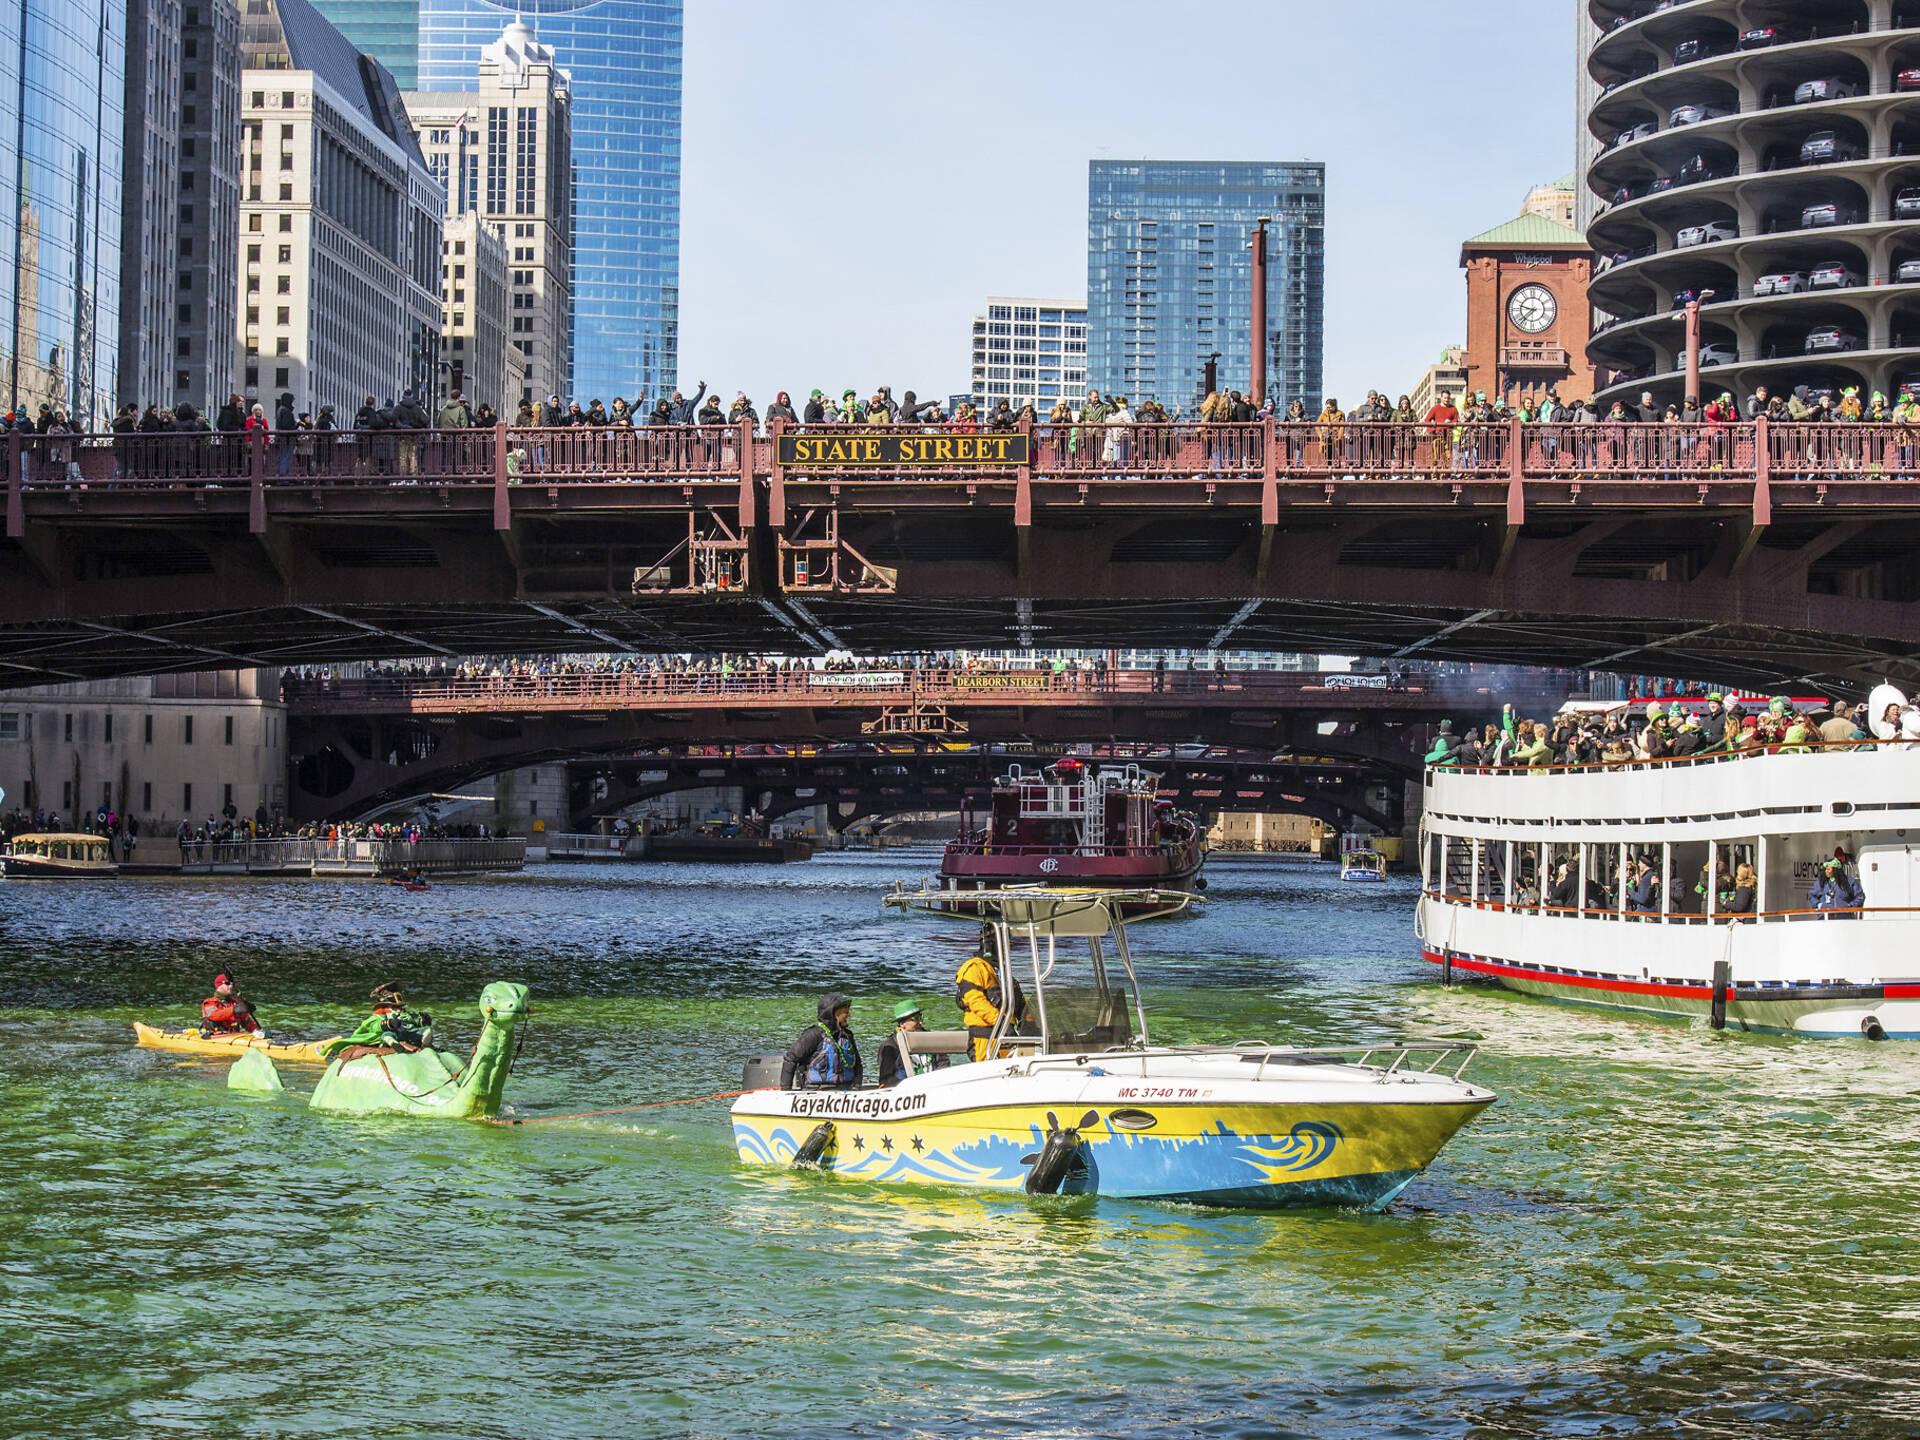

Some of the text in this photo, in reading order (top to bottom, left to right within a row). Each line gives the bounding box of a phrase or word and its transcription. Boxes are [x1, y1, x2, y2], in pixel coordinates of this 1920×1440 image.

[1515, 254, 1552, 267] Whirlpool
[795, 438, 1012, 460] STATE STREET
[957, 676, 1046, 687] DEARBORN STREET
[1007, 819, 1018, 836] 2
[1117, 1087, 1198, 1098] MC 3740 TM
[790, 1092, 926, 1117] kayakchicago.com
